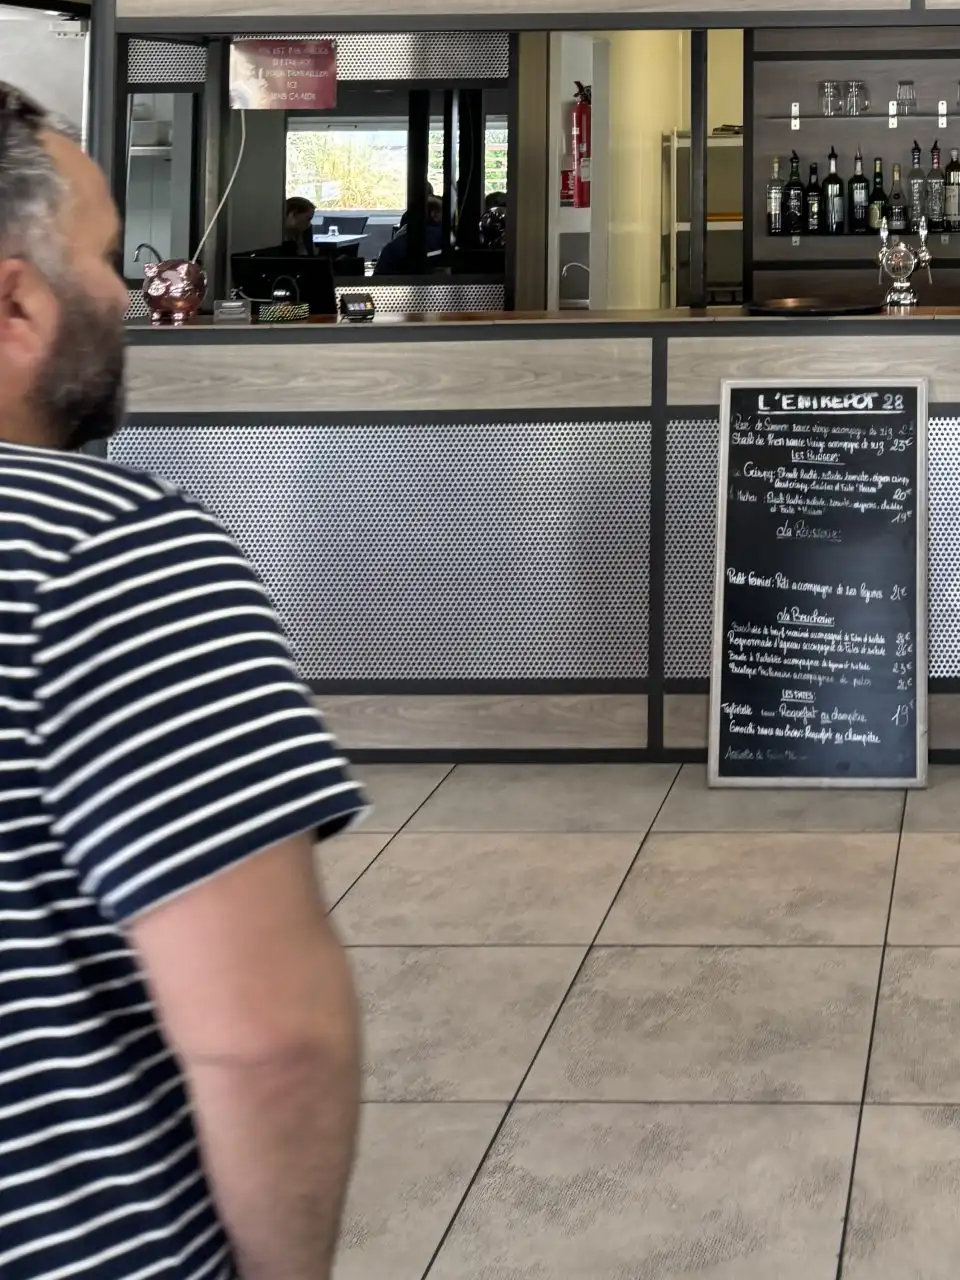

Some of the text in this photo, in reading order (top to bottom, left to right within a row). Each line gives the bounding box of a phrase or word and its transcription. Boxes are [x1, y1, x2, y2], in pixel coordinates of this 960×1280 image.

[882, 393, 904, 410] 28
[755, 420, 763, 431] de
[880, 426, 893, 441] riz
[756, 434, 765, 446] de
[871, 441, 884, 457] riz
[791, 449, 804, 460] LES
[836, 583, 844, 595] de
